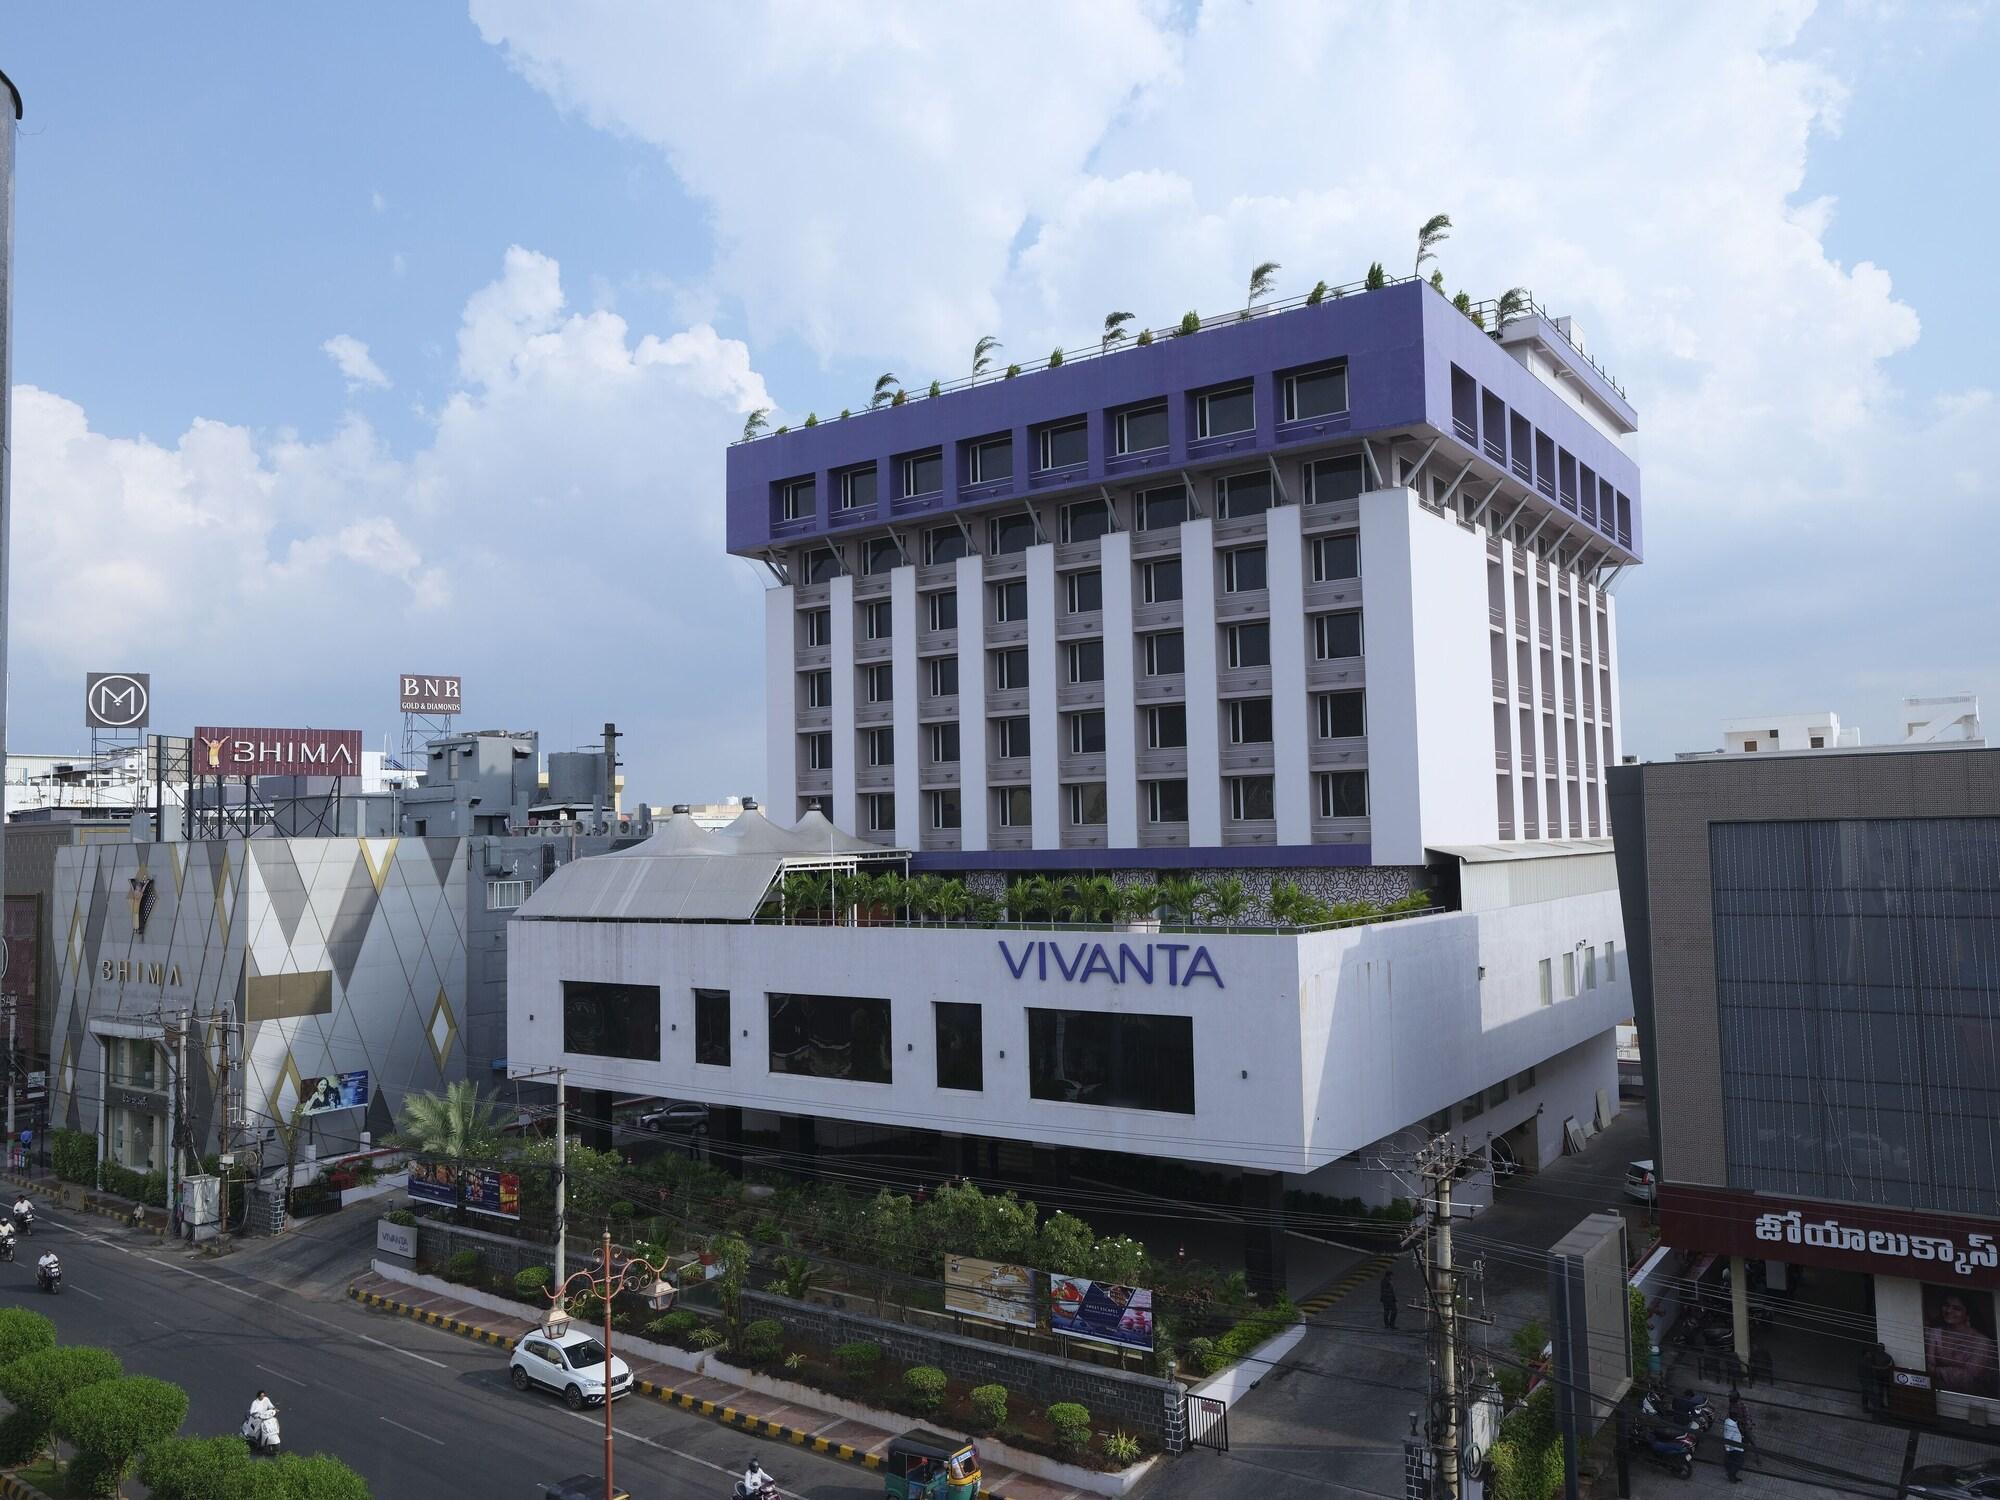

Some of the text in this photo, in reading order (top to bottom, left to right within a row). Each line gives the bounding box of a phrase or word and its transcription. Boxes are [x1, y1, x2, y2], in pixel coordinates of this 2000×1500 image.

[403, 678, 460, 698] BNR
[401, 701, 461, 711] GOLD & DIAMONDS
[233, 741, 353, 766] BHIMA
[102, 959, 183, 987] BHIMA
[998, 940, 1225, 989] VIVANTA
[381, 1231, 409, 1246] VIVANTA
